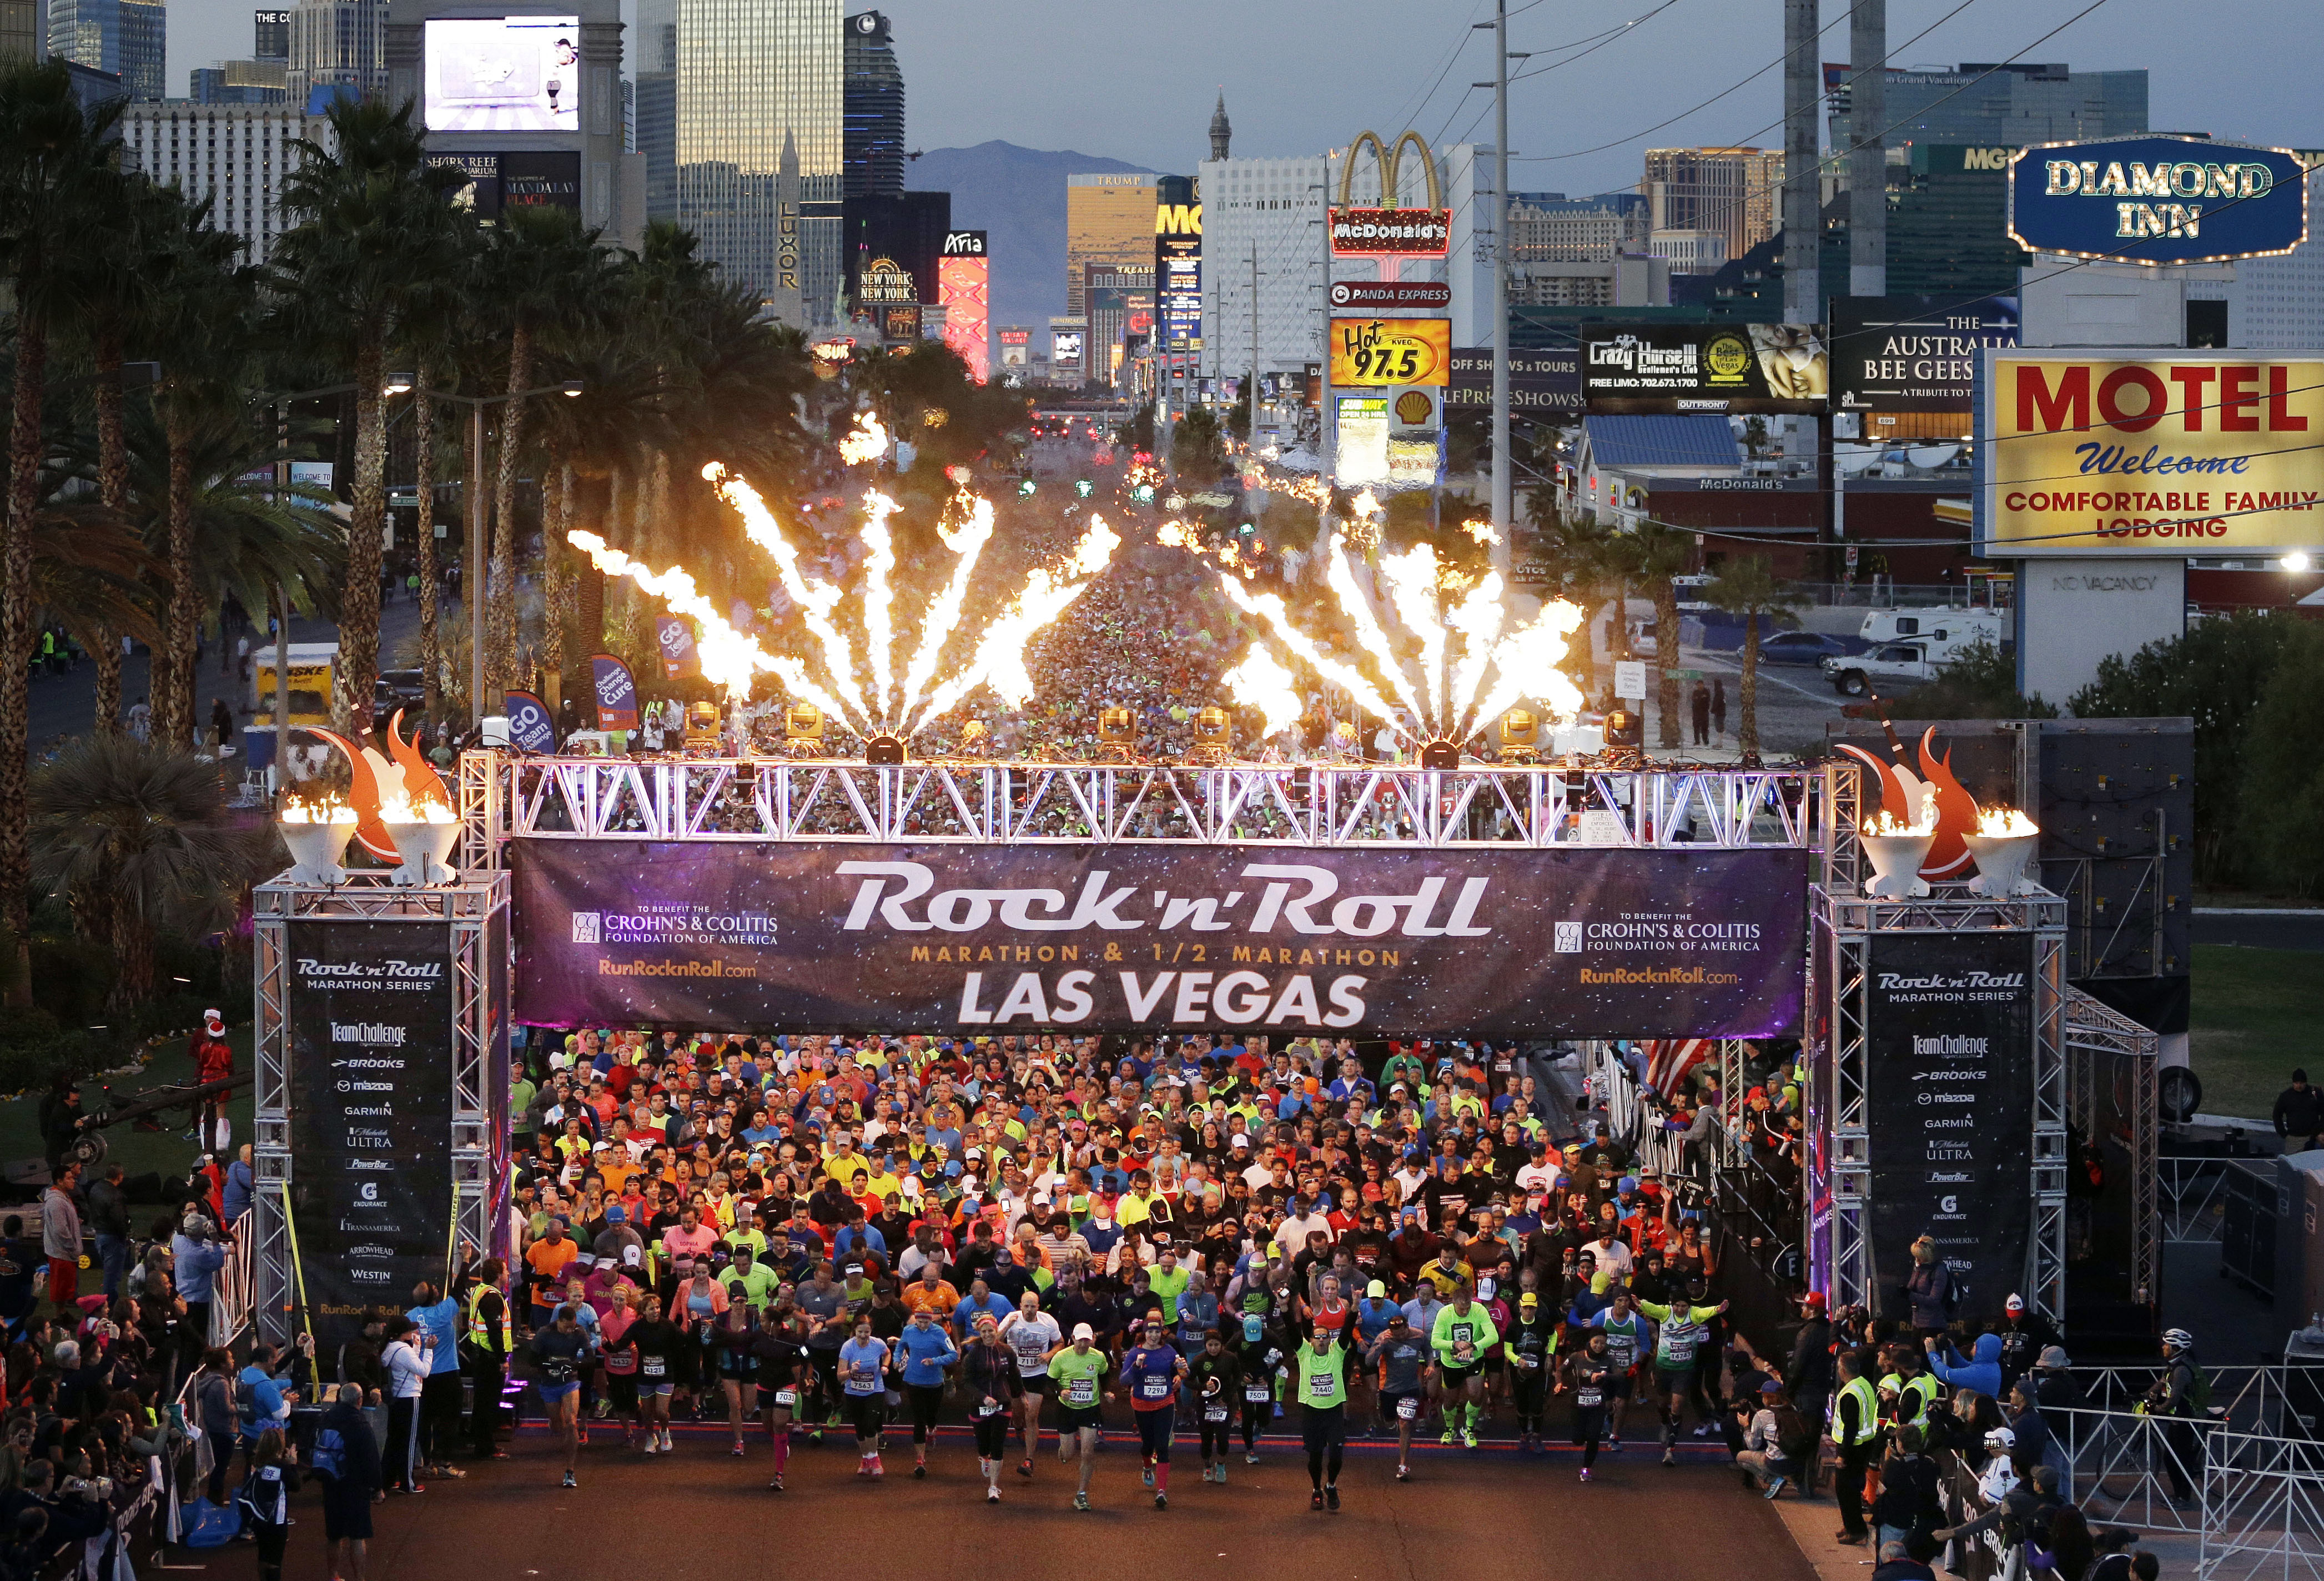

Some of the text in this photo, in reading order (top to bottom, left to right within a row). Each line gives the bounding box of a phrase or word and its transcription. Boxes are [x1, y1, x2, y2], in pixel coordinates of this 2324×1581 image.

[256, 13, 276, 23] THE
[468, 157, 497, 167] REEF
[1097, 177, 1140, 185] TRUMP
[2045, 160, 2273, 198] DIAMOND
[507, 182, 575, 193] MANDALAY
[506, 194, 547, 205] PLACE
[2116, 203, 2202, 239] INN
[1334, 223, 1447, 239] McDonald's
[778, 202, 798, 289] LUXOR
[944, 233, 983, 253] Aria
[861, 274, 911, 285] NEW YORK
[861, 288, 911, 299] NEW YORK
[1353, 289, 1449, 300] PANDA EXPRESS
[1946, 317, 1979, 329] THE
[1344, 321, 1385, 356] Hot
[1354, 348, 1420, 379] 97.5
[1451, 359, 1473, 370] OFF
[1476, 360, 1523, 371] SHWS
[1535, 361, 1577, 373] TOURS
[1865, 360, 1973, 380] BEE GEES
[1590, 379, 1698, 387] FREE LIMO: 702.673.1700
[1340, 399, 1388, 410] SUBWAY
[2016, 365, 2308, 433] MOTEL
[2075, 442, 2250, 475] Welcome
[1701, 479, 1783, 490] McDonald's
[2005, 491, 2318, 512] COMFORTABLE FAMILY
[2096, 519, 2228, 538] LODGING
[2053, 576, 2158, 591] NO VACANCY
[596, 667, 622, 689] Challenge
[598, 672, 627, 696] Change
[603, 681, 633, 706] Cure
[509, 706, 539, 734] GO
[517, 722, 549, 747] Team
[523, 731, 552, 752] Challenge
[1445, 802, 1452, 815] 2
[834, 860, 1492, 937] Rock 'n' Roll
[605, 914, 778, 933] CROHN'S & COLITIS
[1587, 924, 1760, 939] CROHN'S & COLITIS
[605, 933, 778, 945] FOUNDATION OF AMERICA
[1587, 941, 1760, 951] FOUNDATION OF AMERICA
[911, 942, 1399, 966] MARATHON & 1/2 MARATHON
[297, 958, 365, 976] Rock
[385, 960, 442, 977] Roll
[599, 959, 756, 978] RunRocknRoll.com
[1581, 967, 1738, 984] RunRocknRoll.com
[1878, 973, 1947, 989] Rock
[1968, 971, 2024, 988] Roll
[307, 980, 381, 989] MARATHON
[958, 969, 1368, 1028] LAS VEGAS
[1889, 993, 1964, 1003] MARATHON
[348, 1059, 405, 1068] BROOKS
[1929, 1071, 1987, 1080] BROOKS
[1925, 1120, 1974, 1128] GARMIN
[347, 1137, 392, 1147] ULTRA
[1927, 1150, 1973, 1160] ULTRA
[351, 1159, 388, 1169] PowerBar
[1931, 1172, 1969, 1182] PowerBar
[1687, 1181, 1704, 1191] CORRAL
[349, 1246, 394, 1256] ARROWHEAD
[1789, 1257, 1796, 1277] E
[351, 1269, 391, 1281] WESTIN
[595, 1290, 612, 1298] RUN
